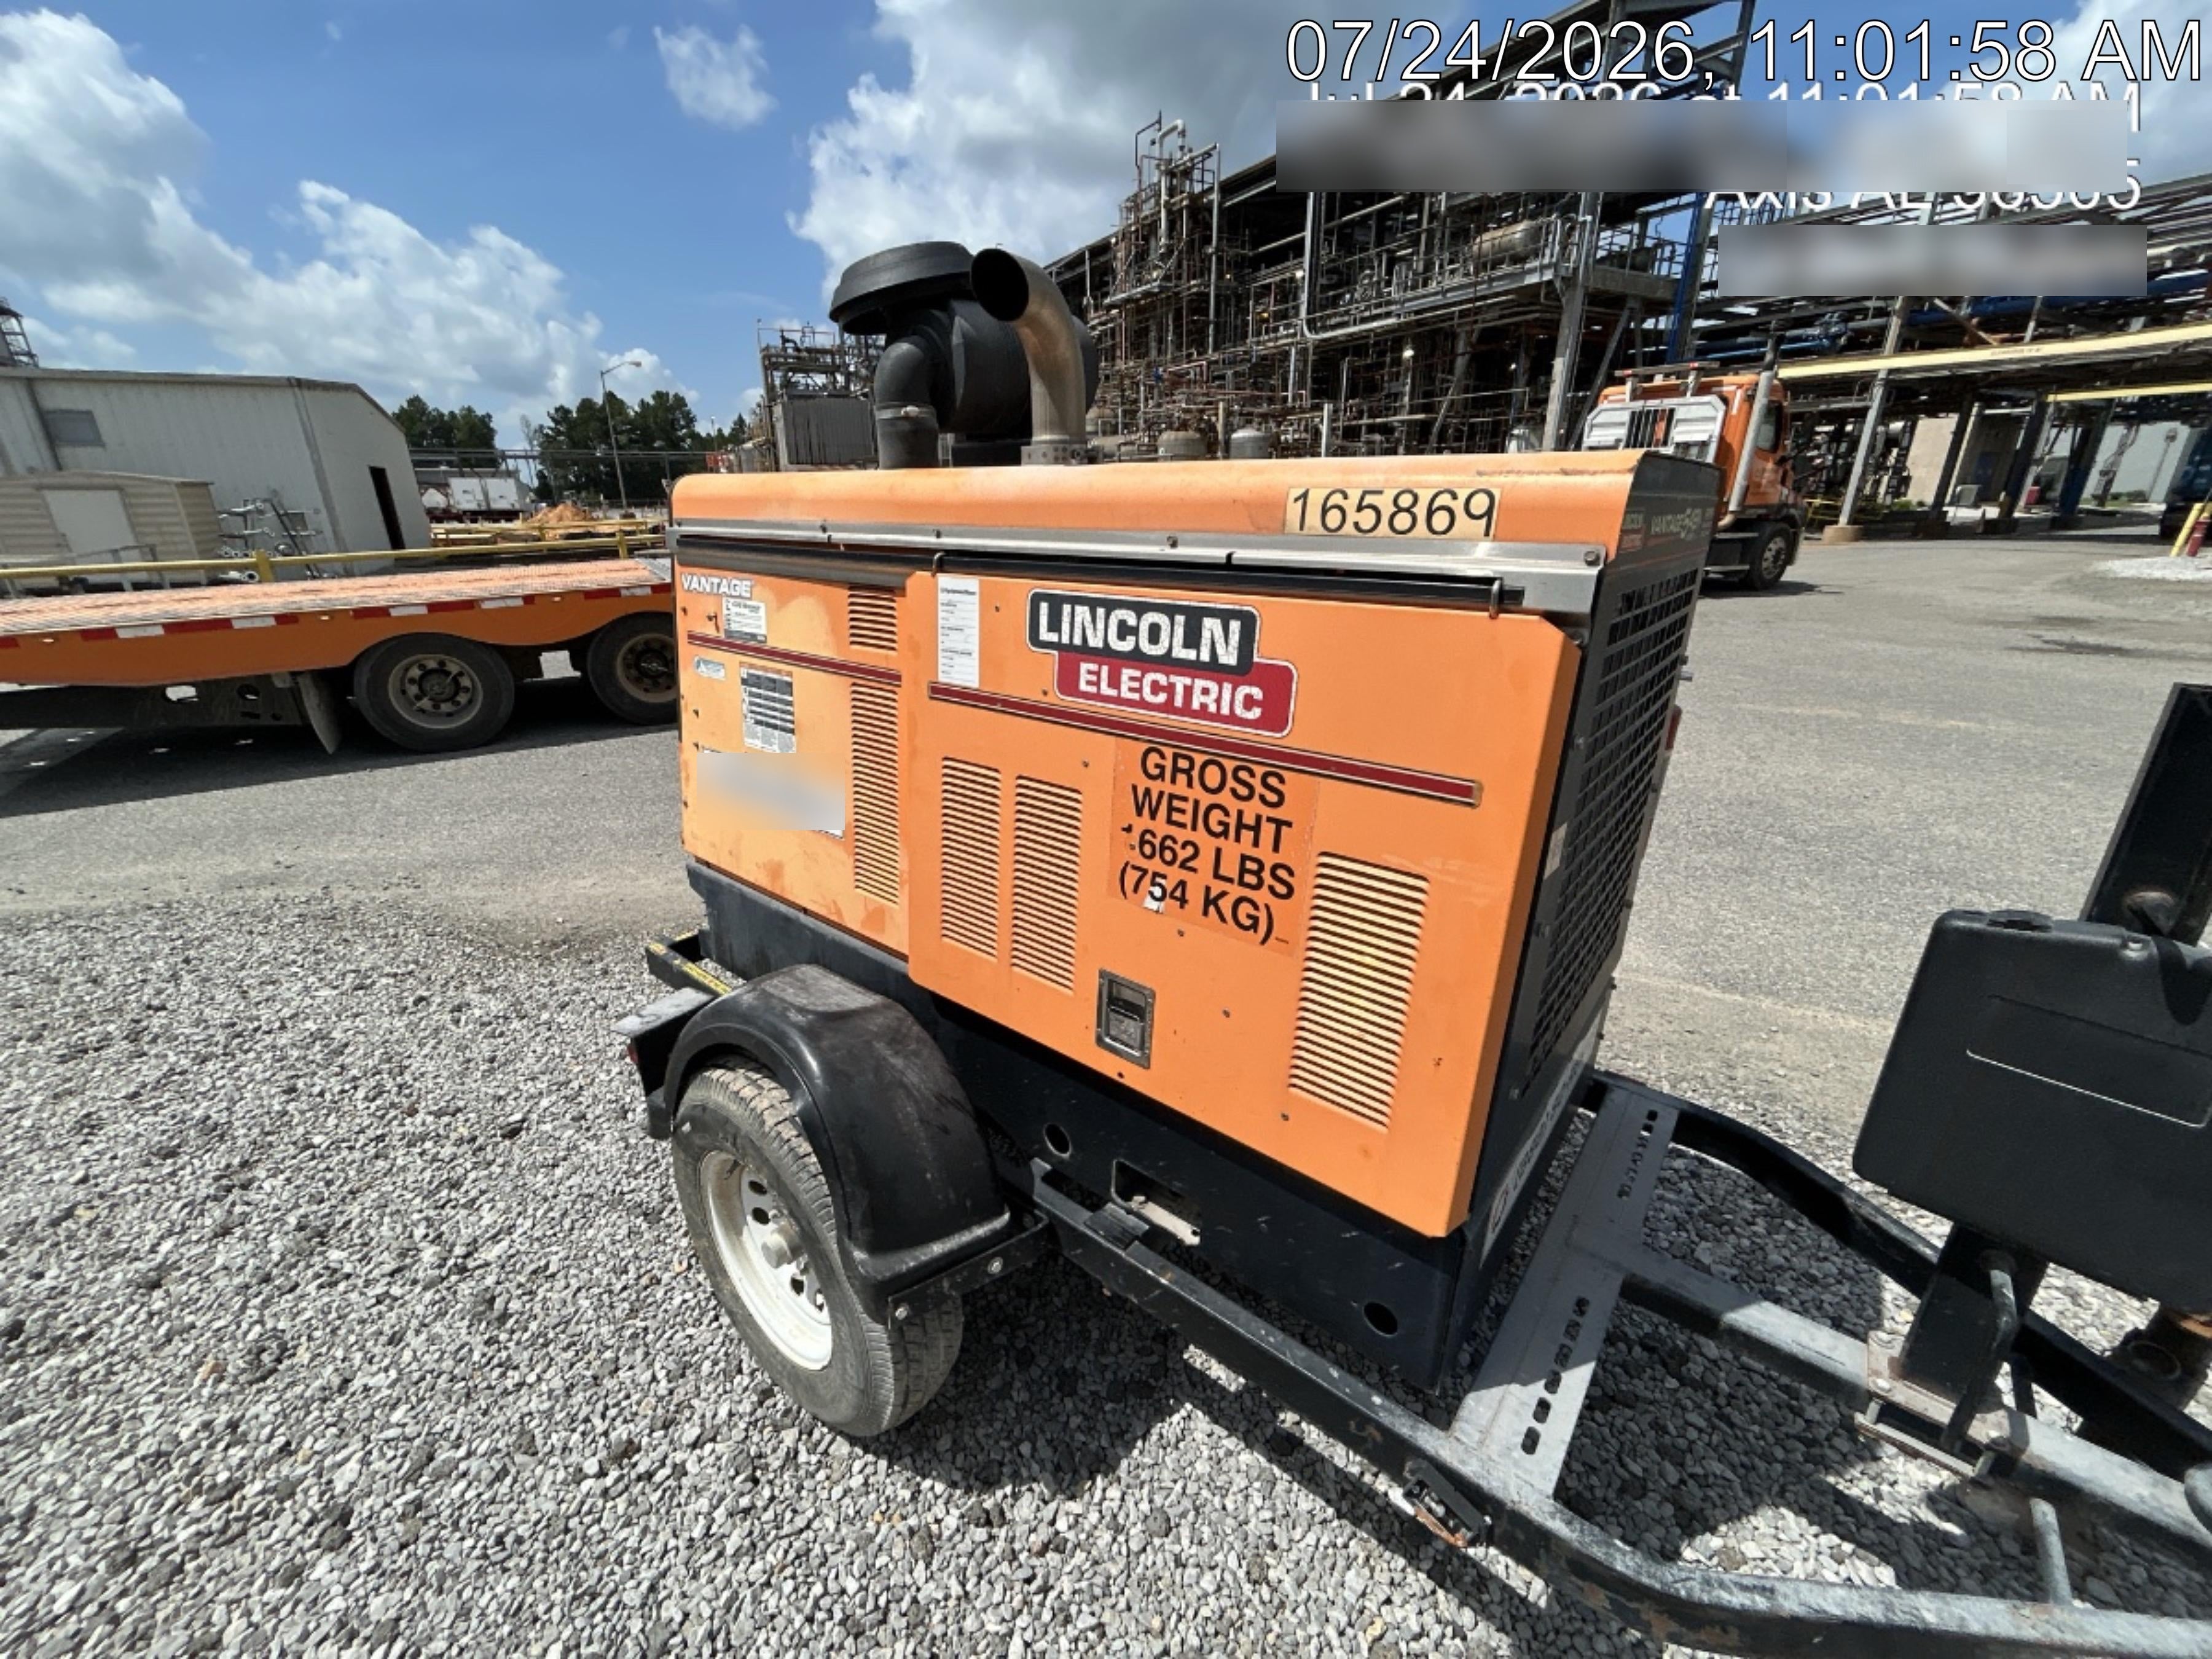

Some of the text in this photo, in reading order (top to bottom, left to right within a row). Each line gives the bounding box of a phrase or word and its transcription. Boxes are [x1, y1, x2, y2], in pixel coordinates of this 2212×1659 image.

[1293, 488, 1496, 537] 165869
[681, 573, 752, 599] VANTAGE
[1039, 602, 1241, 666] LINCOLN
[1079, 661, 1263, 720] ELECTRIC
[1140, 747, 1285, 808] GROSS
[1131, 783, 1293, 853] WEIGHT
[1121, 823, 1295, 900] 662 LBS
[1119, 860, 1274, 945] (754 KG)
